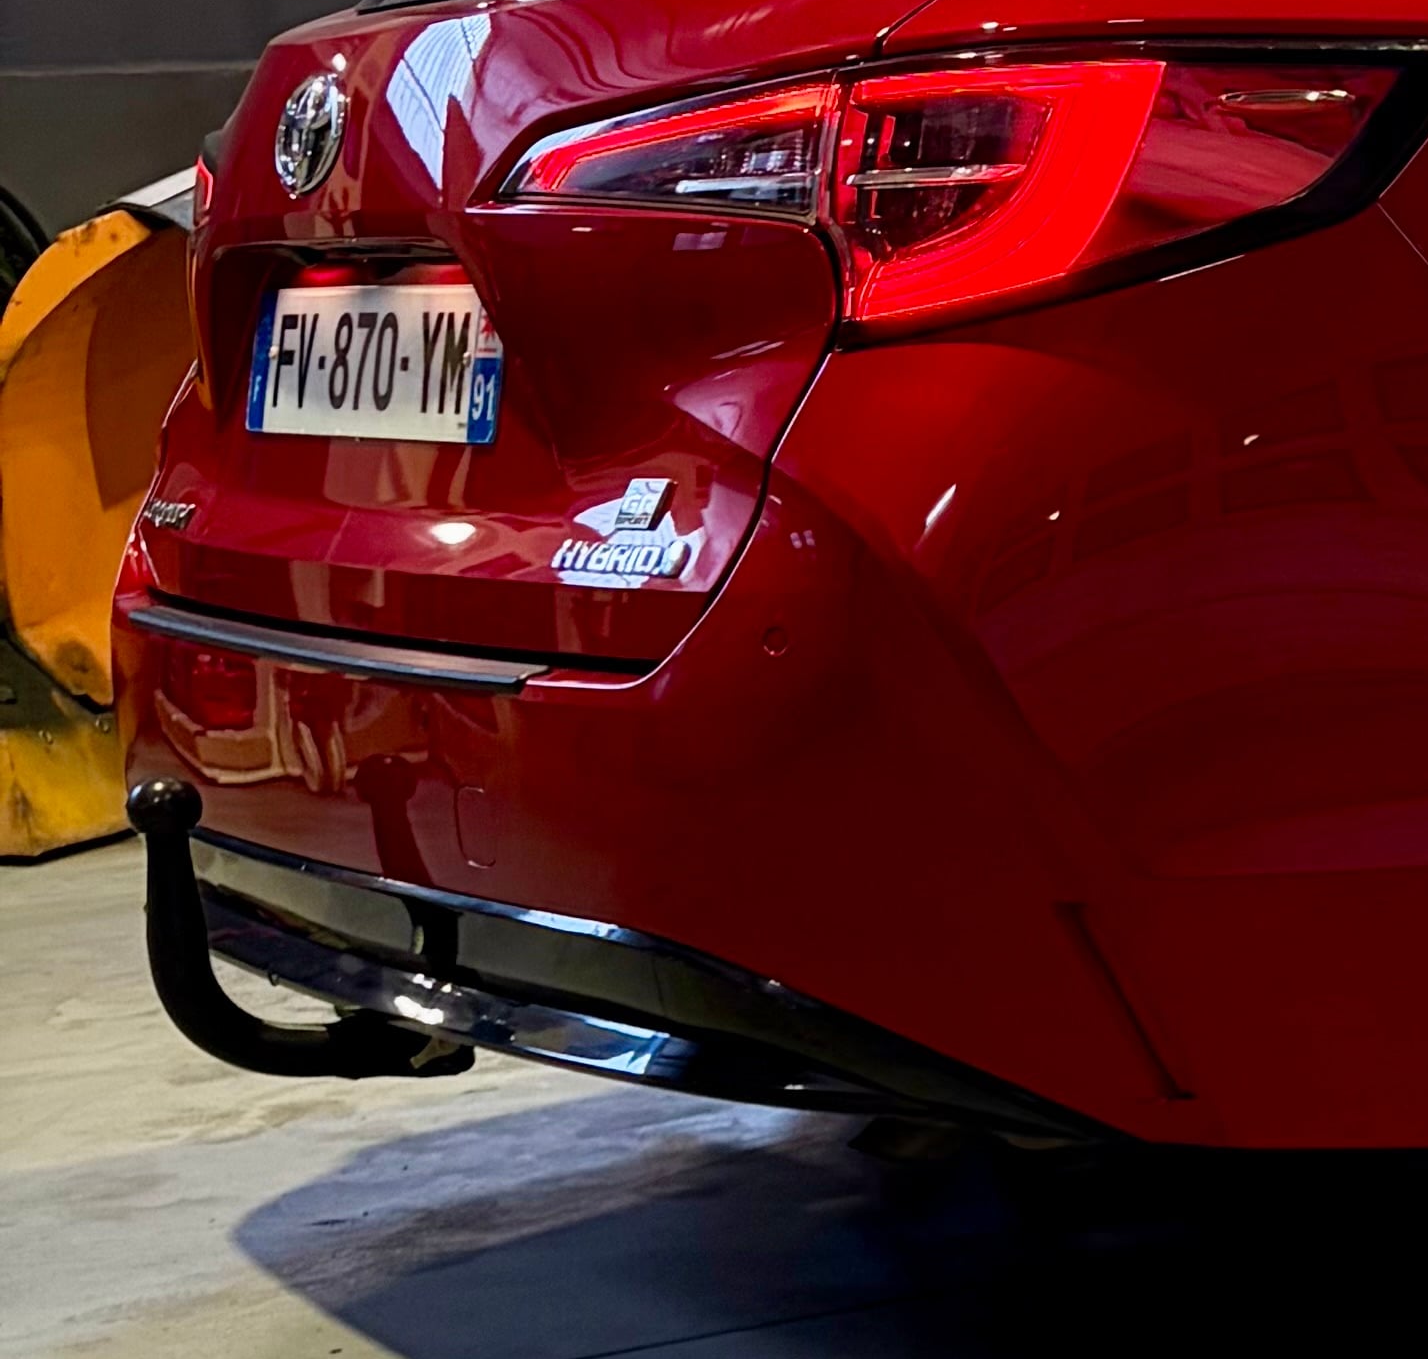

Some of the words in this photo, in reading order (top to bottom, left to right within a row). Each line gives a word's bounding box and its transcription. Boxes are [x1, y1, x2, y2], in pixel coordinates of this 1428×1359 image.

[272, 311, 472, 415] FV-870-YM
[470, 373, 496, 421] 91
[551, 538, 661, 575] HYBRID
